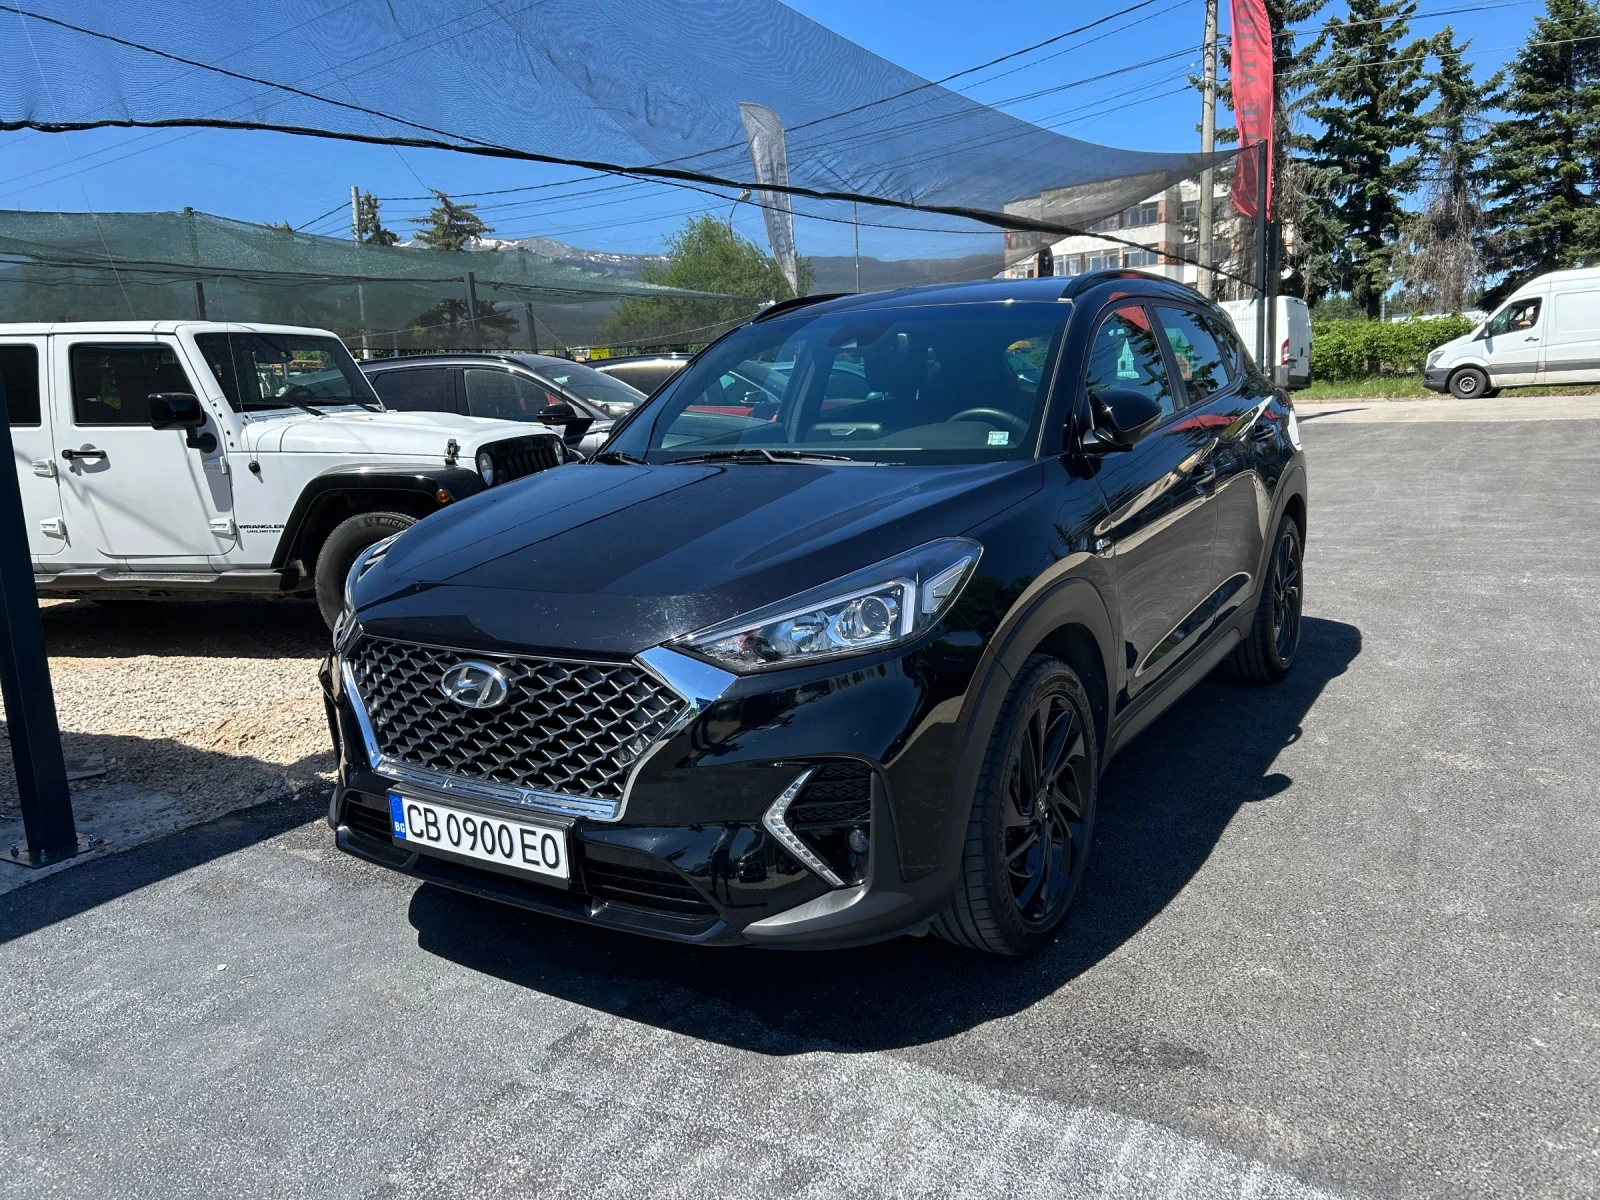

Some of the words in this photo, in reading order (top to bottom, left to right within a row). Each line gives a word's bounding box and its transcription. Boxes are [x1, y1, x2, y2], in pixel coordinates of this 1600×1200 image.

[394, 821, 406, 833] BG
[407, 804, 441, 842] CB
[446, 813, 514, 859] 0900
[519, 827, 560, 869] EO
